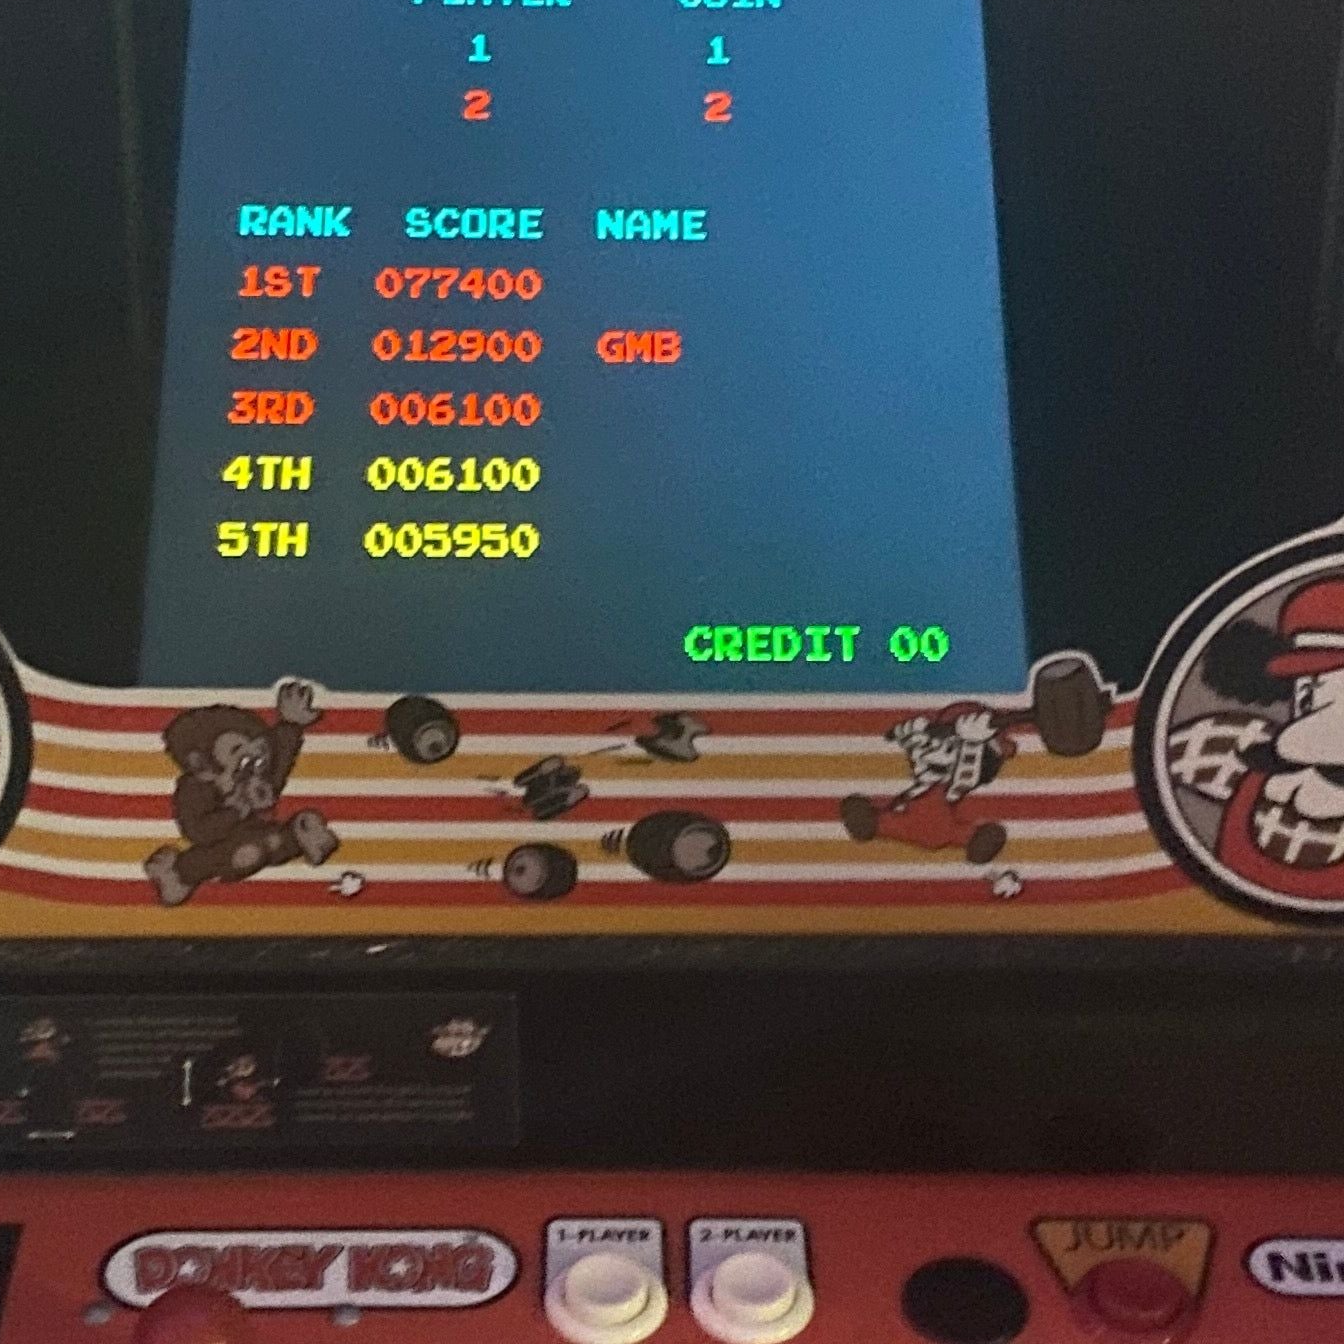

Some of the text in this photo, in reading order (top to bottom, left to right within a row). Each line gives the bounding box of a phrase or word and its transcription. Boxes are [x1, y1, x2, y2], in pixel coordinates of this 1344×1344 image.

[467, 33, 493, 64] 1
[705, 35, 731, 66] 1
[462, 89, 492, 122] 2
[703, 91, 733, 123] 2
[238, 204, 708, 242] RANK SCORE NAME
[237, 265, 544, 301] 1ST 077400
[230, 327, 683, 364] 2ND 012900 GMB
[226, 390, 543, 427] 3RD 006100
[221, 455, 542, 493] 4TH 006100
[216, 521, 541, 560] 5TH 005950
[683, 624, 950, 665] CREDIT 00
[1064, 1223, 1187, 1252] JUMP
[133, 1243, 494, 1294] DONKEY KONG
